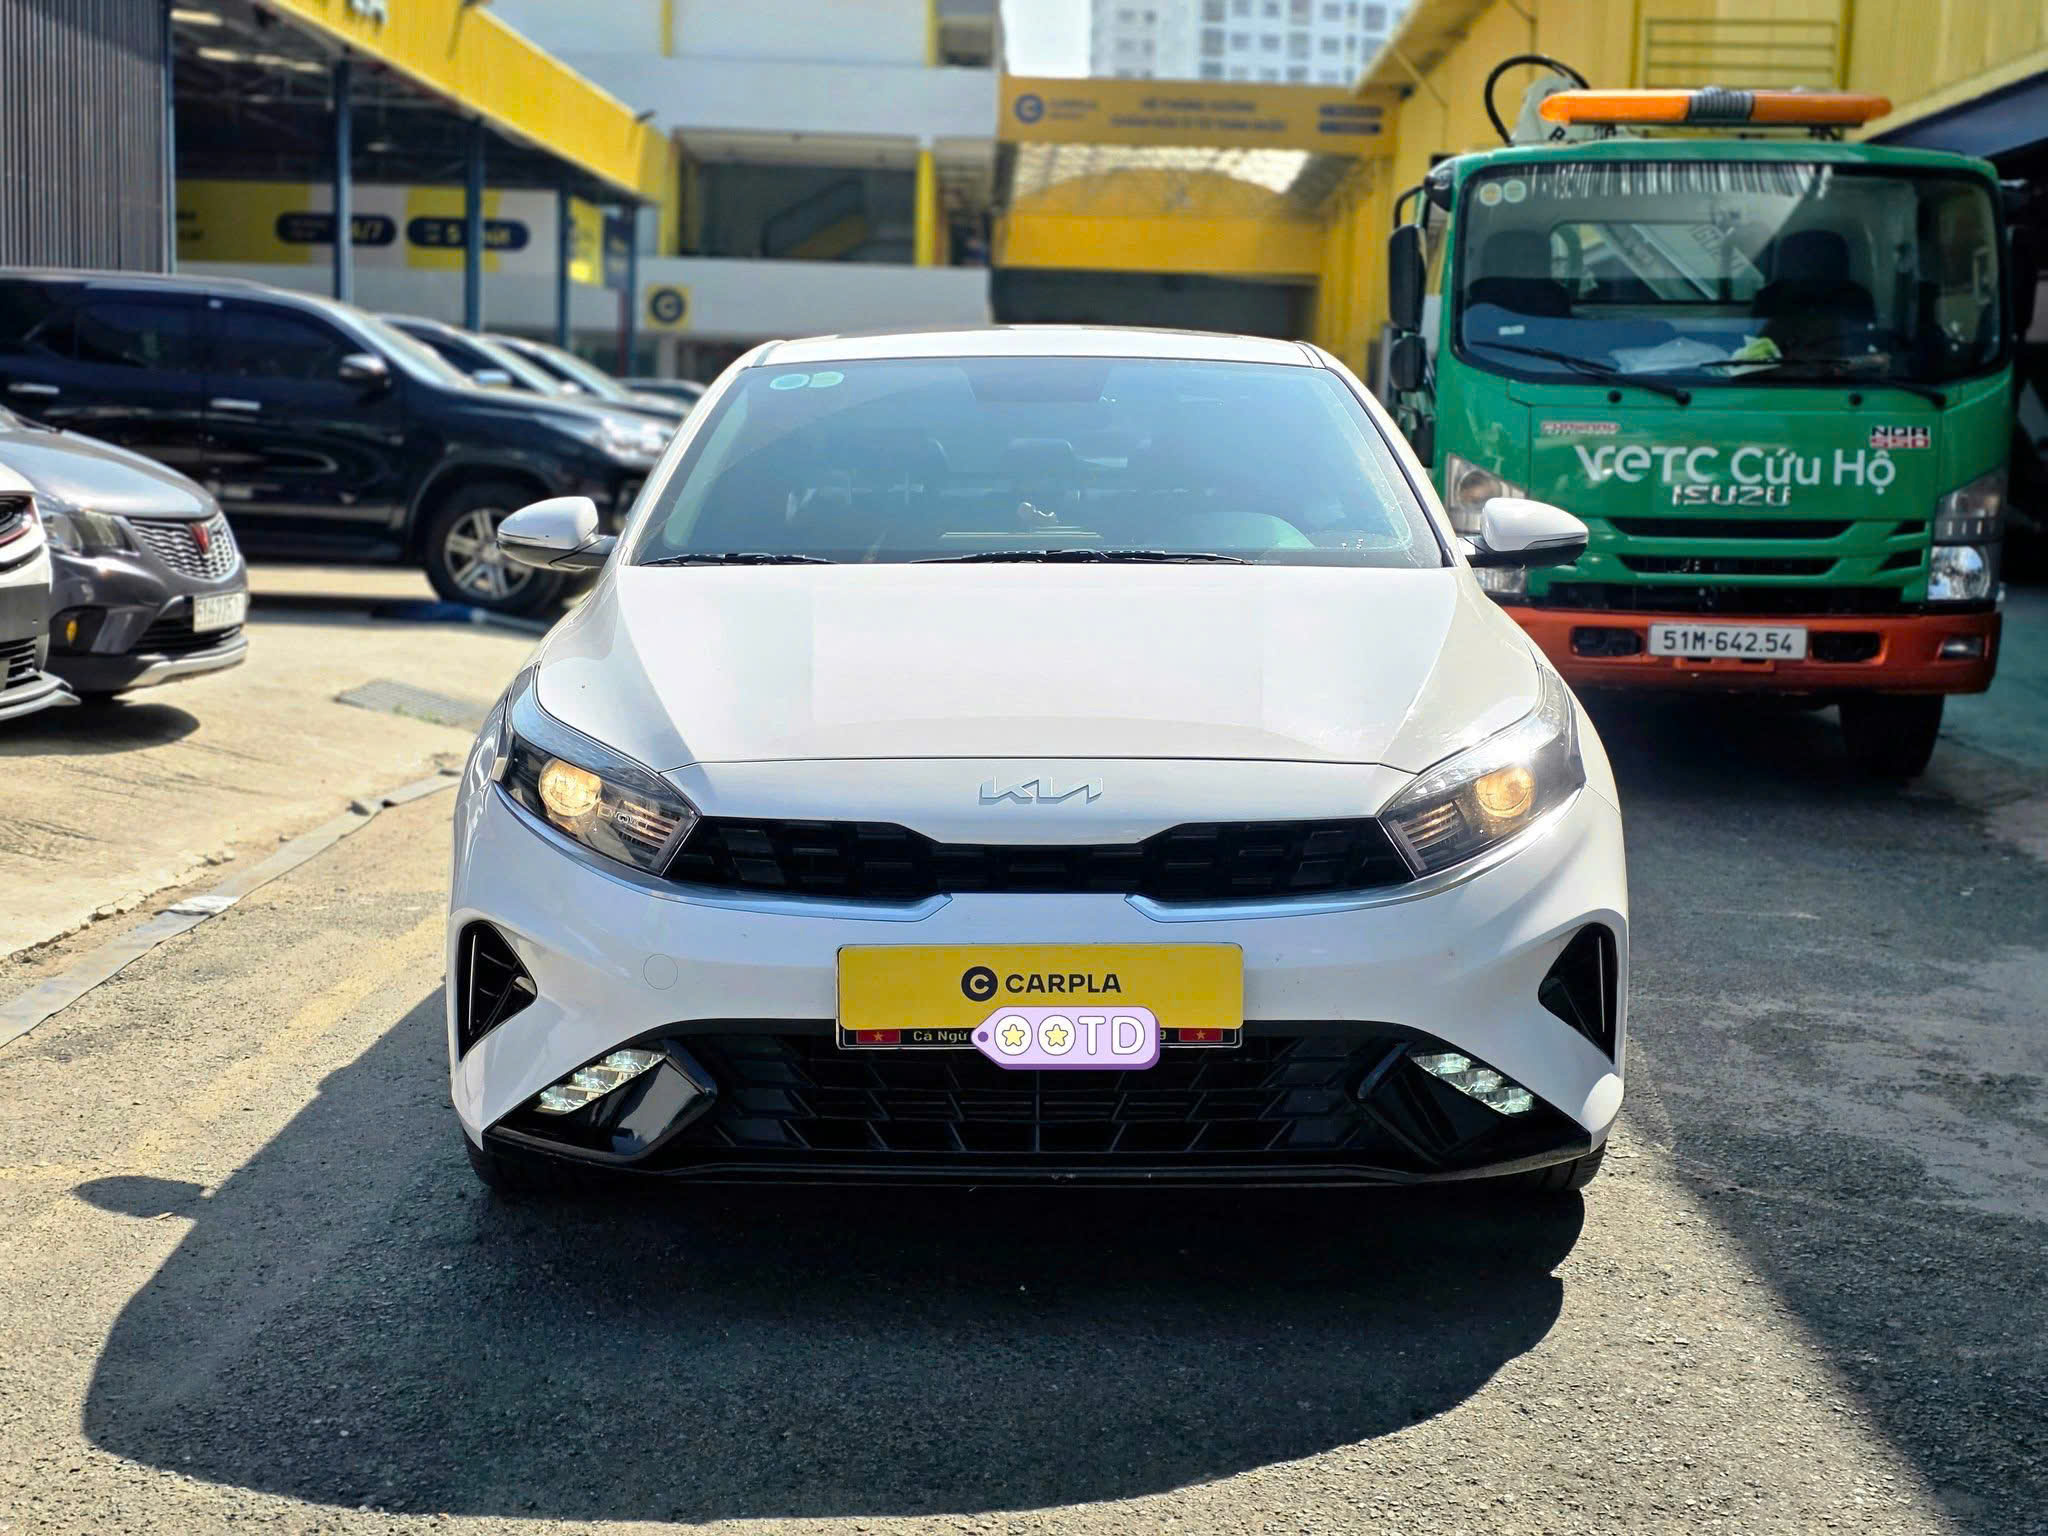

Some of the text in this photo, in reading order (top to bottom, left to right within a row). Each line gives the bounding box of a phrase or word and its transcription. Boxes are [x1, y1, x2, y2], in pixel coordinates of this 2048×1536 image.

[1730, 445, 1819, 486] Cứu
[1834, 449, 1896, 494] Hộ
[1672, 485, 1791, 506] ISUZU
[1663, 629, 1793, 654] 51M-642.54
[1005, 973, 1122, 994] CARPLA
